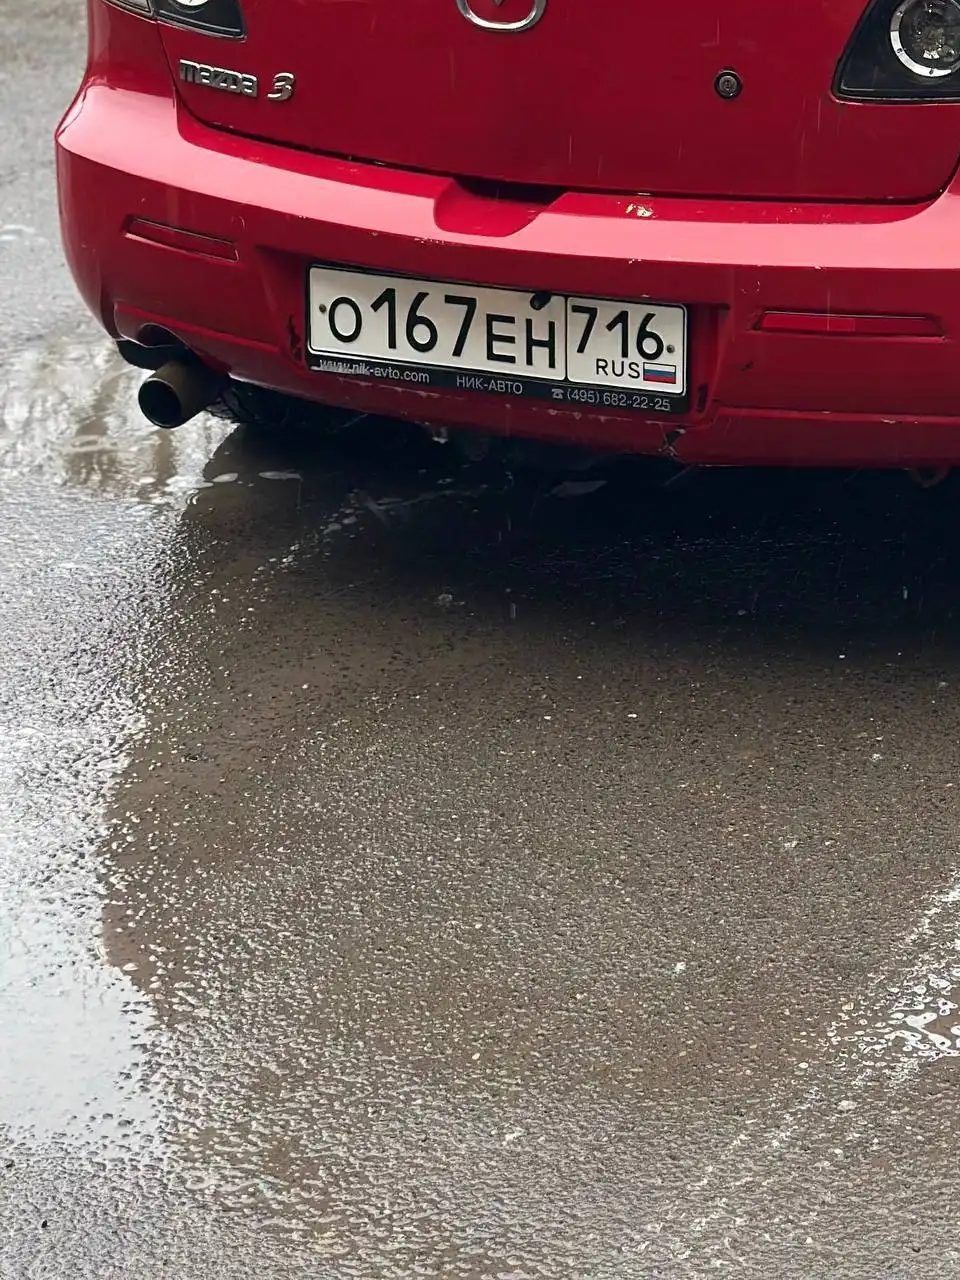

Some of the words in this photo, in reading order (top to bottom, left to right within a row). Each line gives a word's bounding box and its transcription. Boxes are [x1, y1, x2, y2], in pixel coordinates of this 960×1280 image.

[267, 72, 295, 101] 3
[571, 304, 664, 361] 716
[319, 360, 430, 383] www.nik-avto.com
[596, 358, 641, 380] RUS
[456, 375, 524, 396] НИК-АВТО
[567, 388, 600, 405] (495)
[603, 393, 671, 412] 682-22-25
